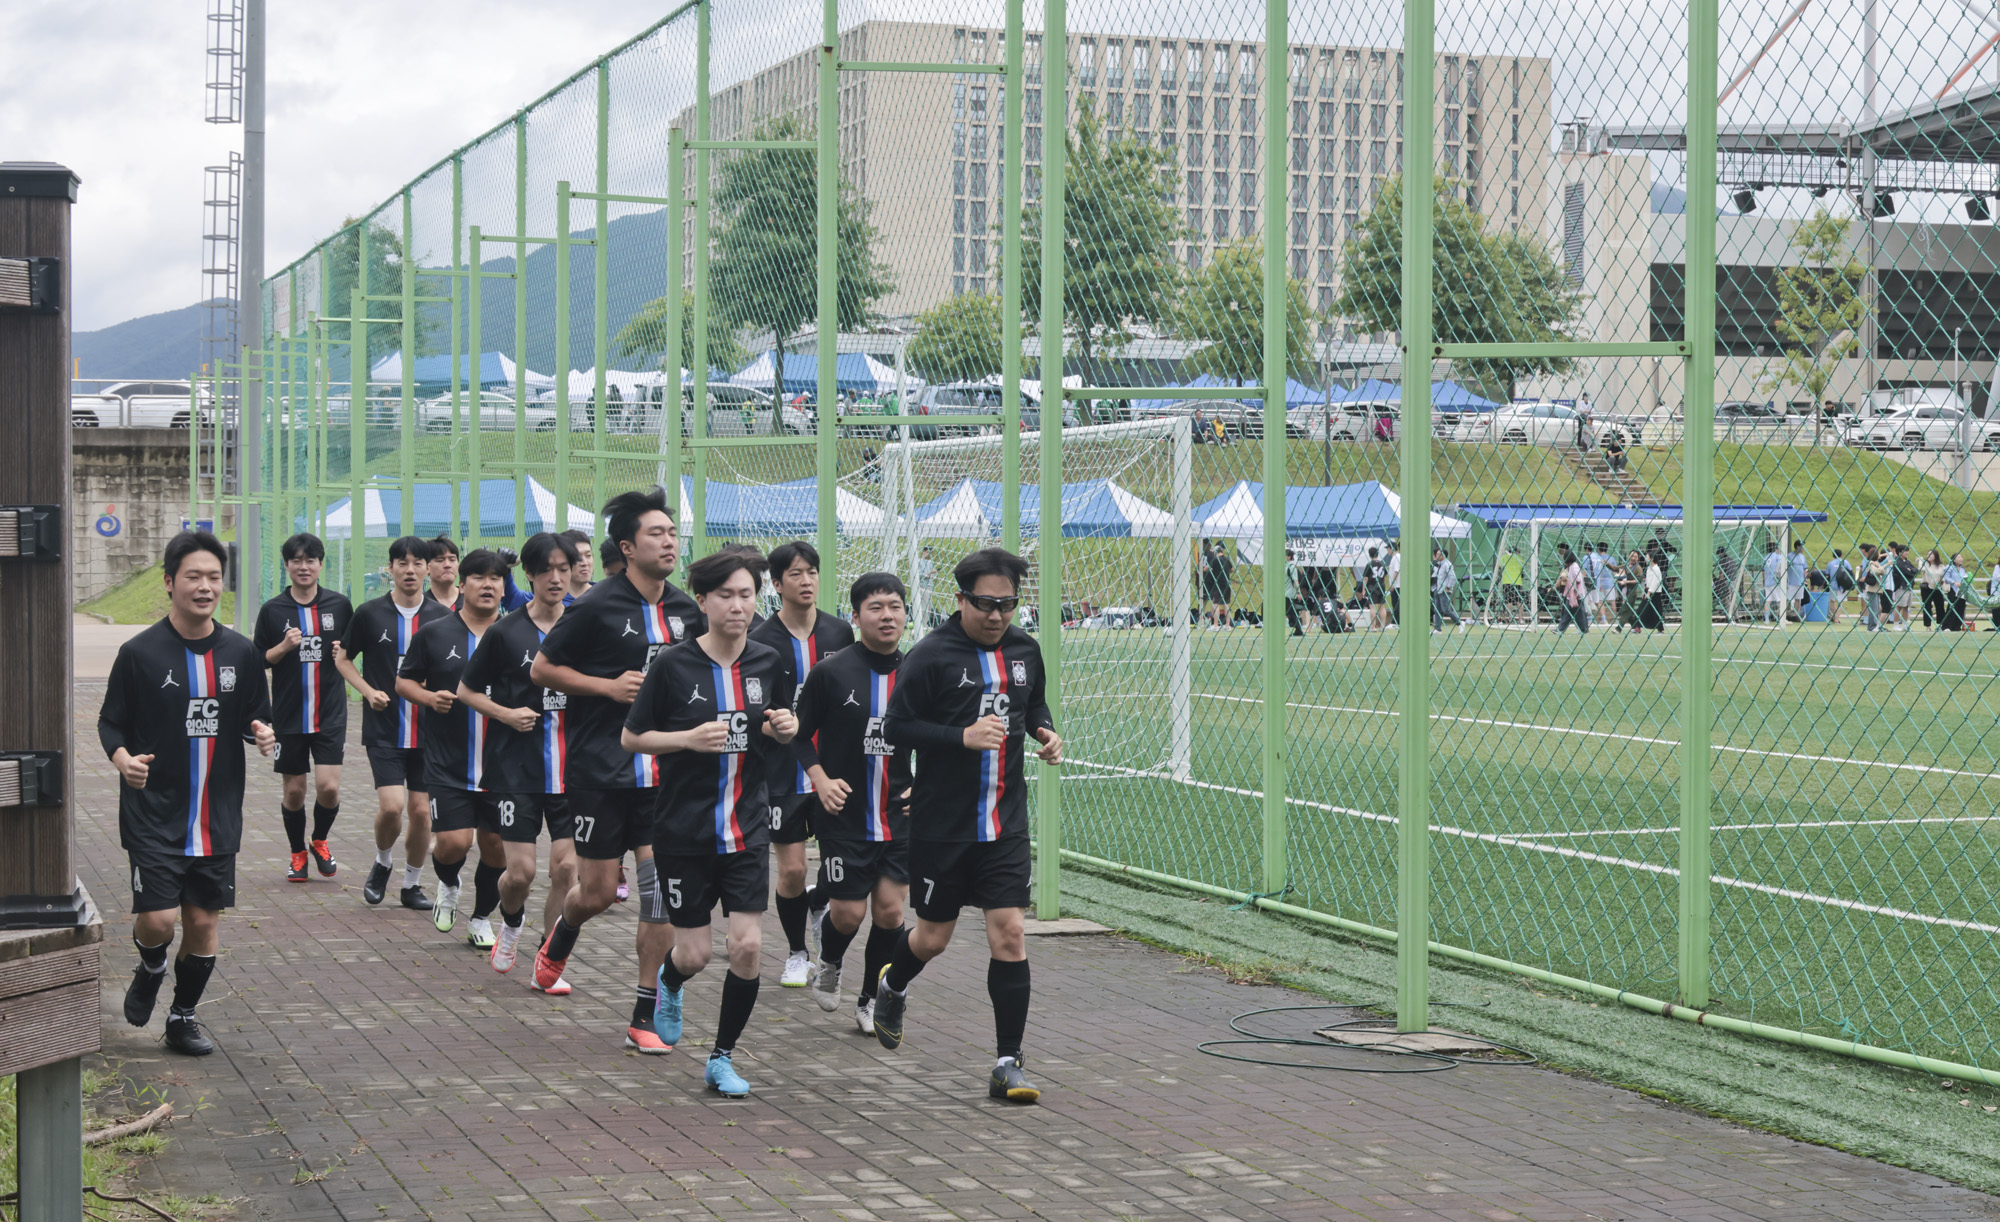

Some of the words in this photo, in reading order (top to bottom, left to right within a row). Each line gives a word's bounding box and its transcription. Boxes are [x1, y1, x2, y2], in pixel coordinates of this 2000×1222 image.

[300, 636, 322, 650] FC
[299, 650, 322, 662] 일요신문
[793, 684, 805, 701] F
[187, 699, 219, 719] FC
[543, 696, 567, 710] 일요신문
[979, 693, 1010, 716] FC
[186, 719, 219, 736] 일요신문
[865, 717, 885, 736] F
[724, 733, 748, 752] 요신문
[498, 800, 515, 826] 18
[575, 815, 595, 842] 27
[134, 866, 143, 893] 4
[825, 857, 844, 882] 16
[668, 878, 682, 908] 5
[923, 878, 935, 905] 7
